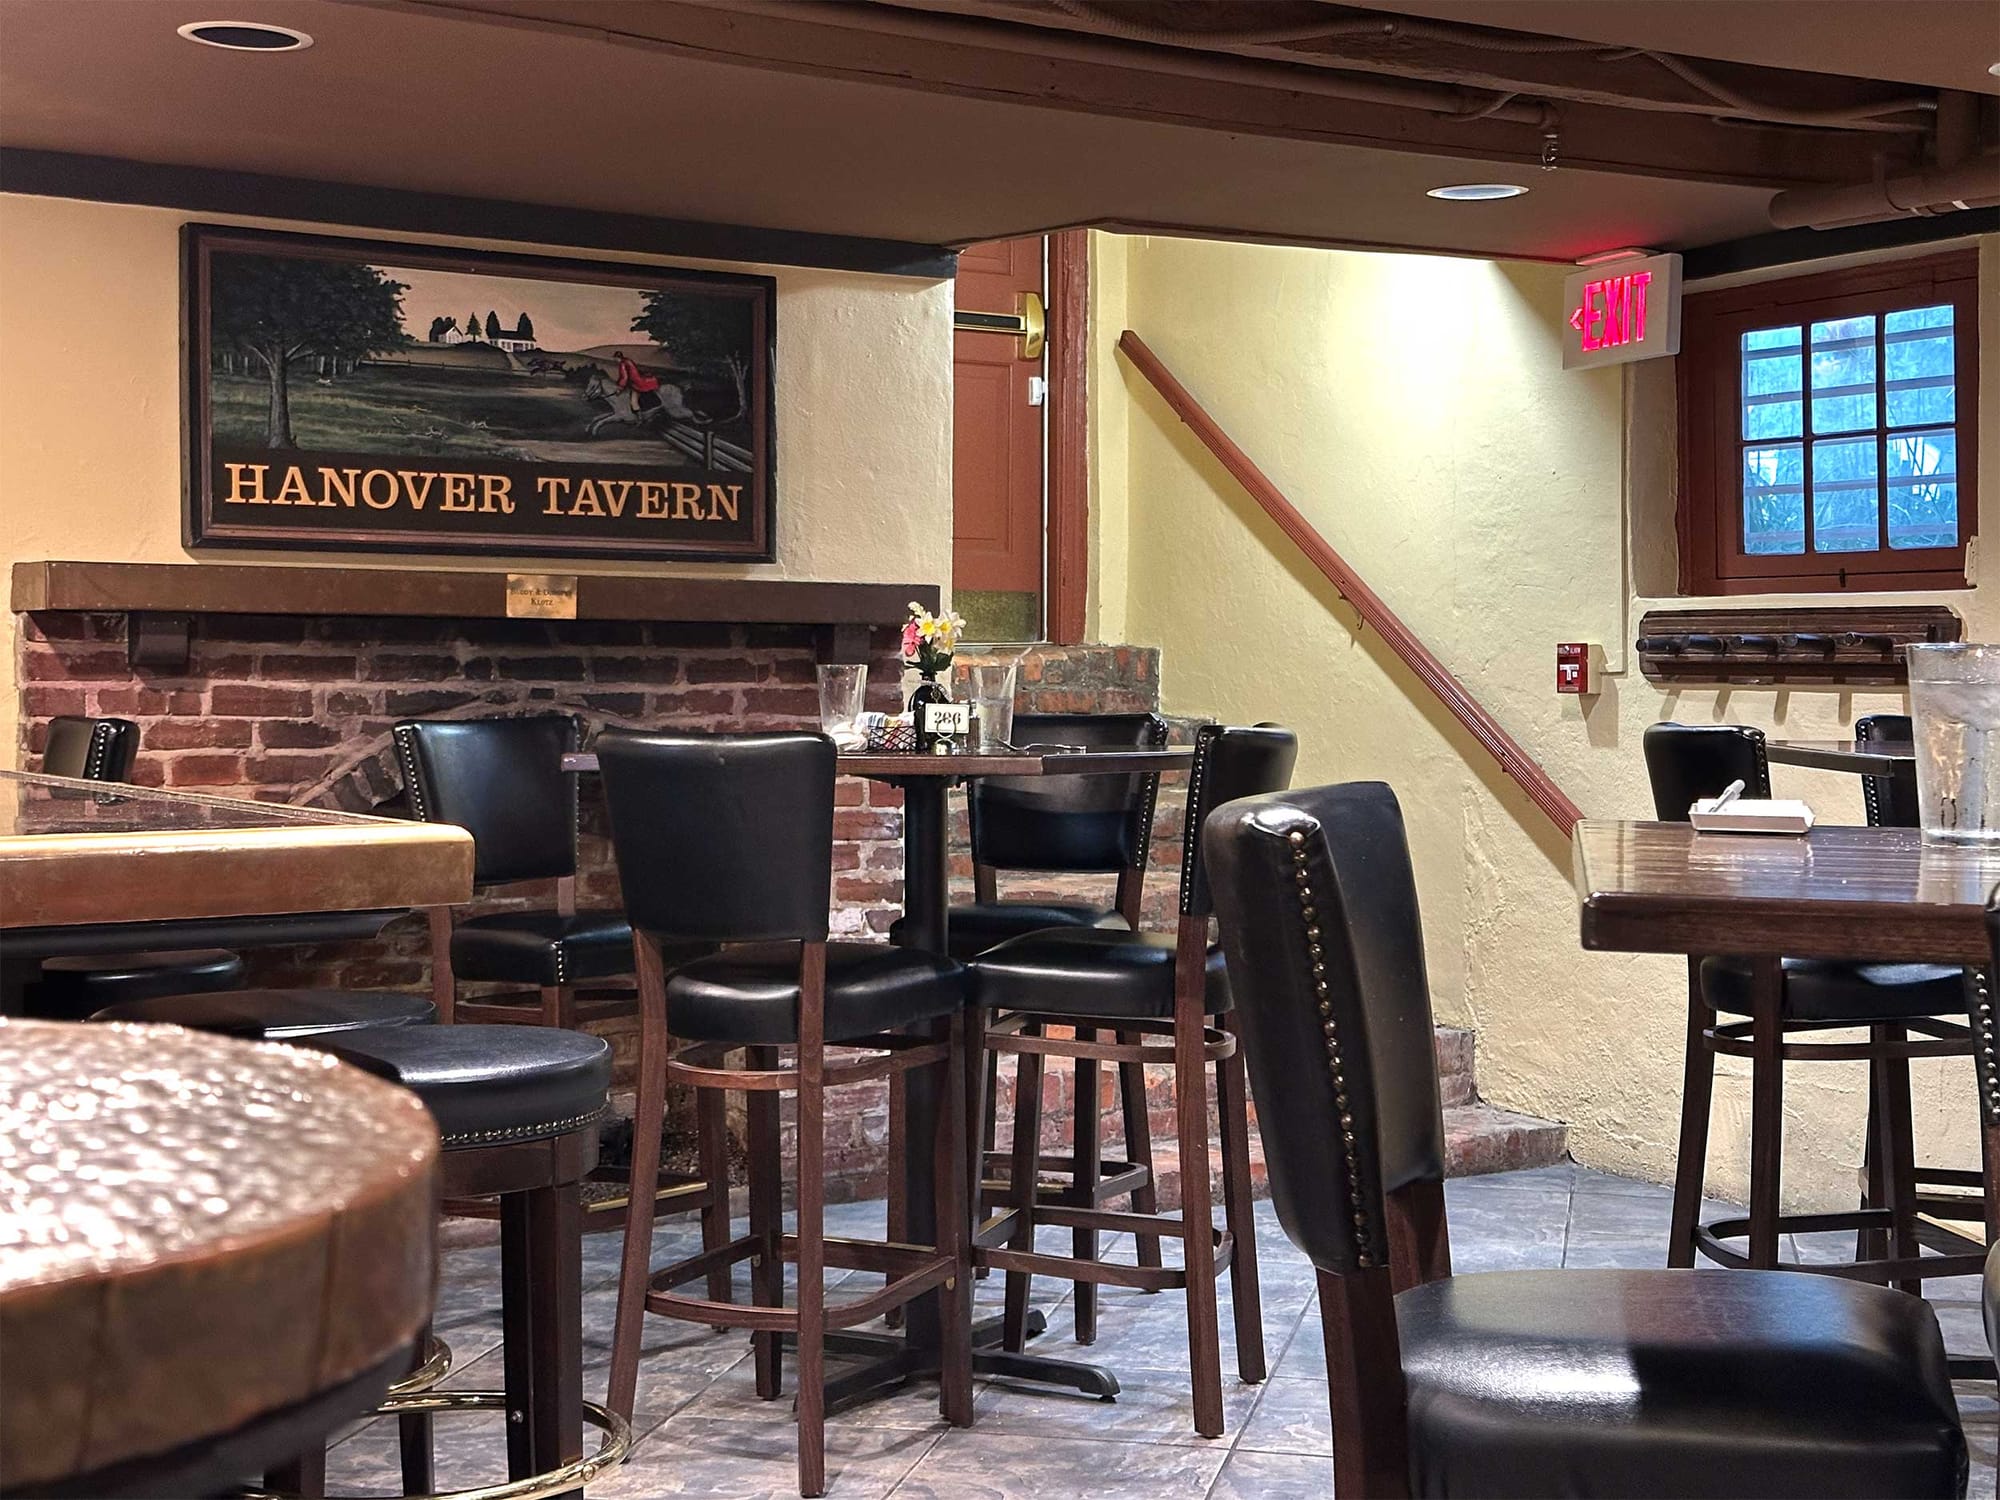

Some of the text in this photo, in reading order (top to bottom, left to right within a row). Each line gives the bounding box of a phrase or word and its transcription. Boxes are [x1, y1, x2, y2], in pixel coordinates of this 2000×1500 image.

[1583, 272, 1652, 351] EXIT
[225, 463, 743, 521] HANOVER TAVERN
